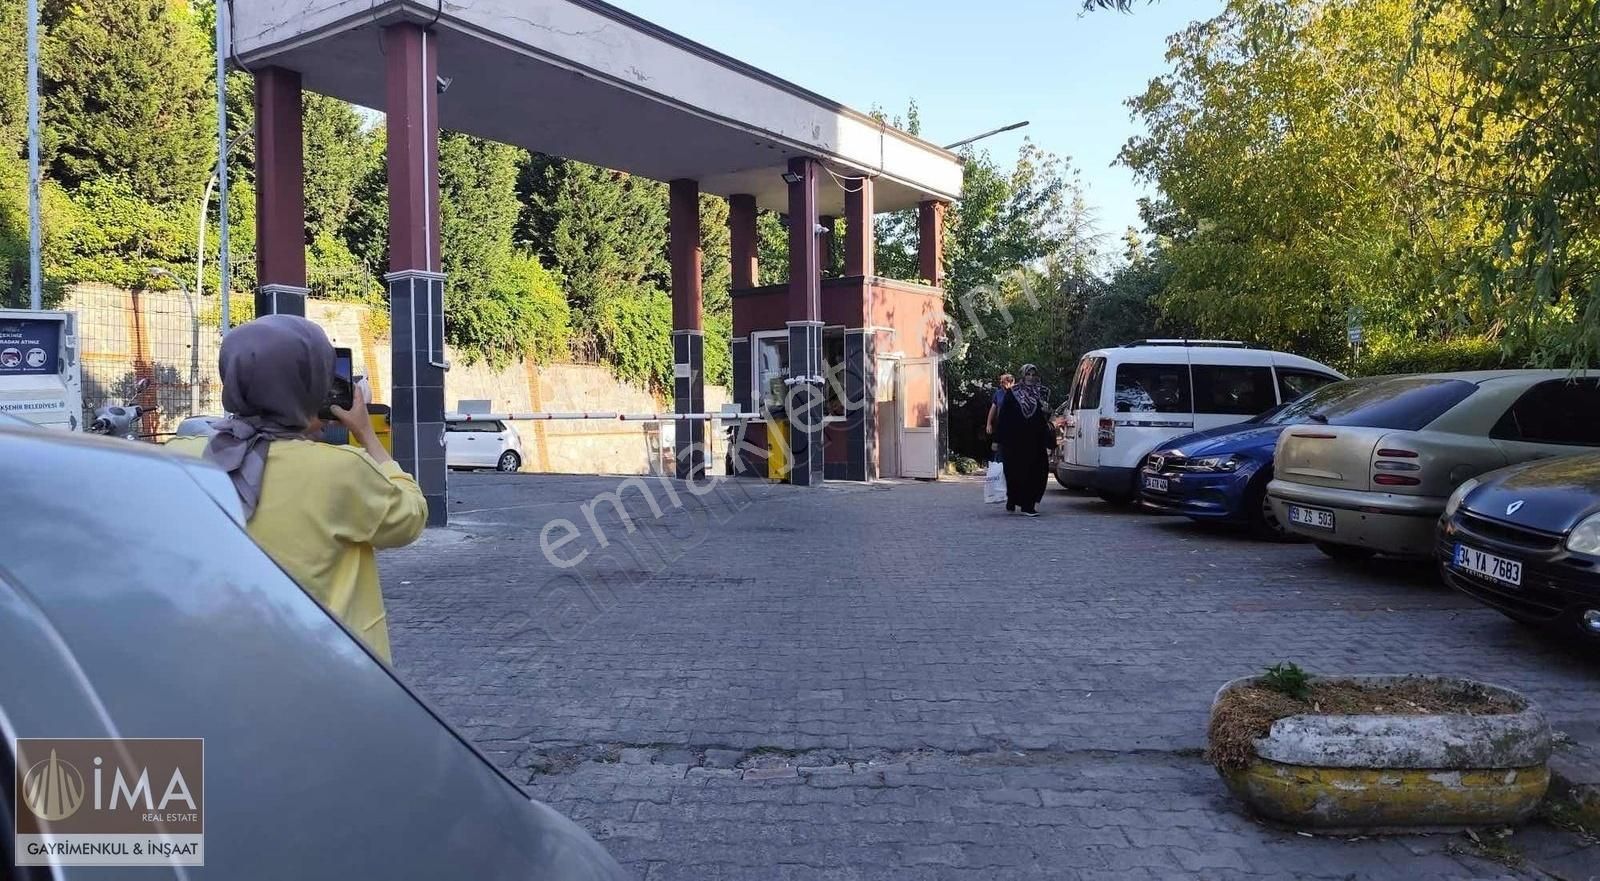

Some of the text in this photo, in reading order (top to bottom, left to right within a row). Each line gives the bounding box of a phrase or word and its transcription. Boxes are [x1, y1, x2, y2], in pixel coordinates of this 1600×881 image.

[1291, 506, 1333, 526] 59 ZS 503
[1459, 547, 1470, 567] 34
[1475, 551, 1487, 573] YA
[1492, 557, 1520, 582] 7683
